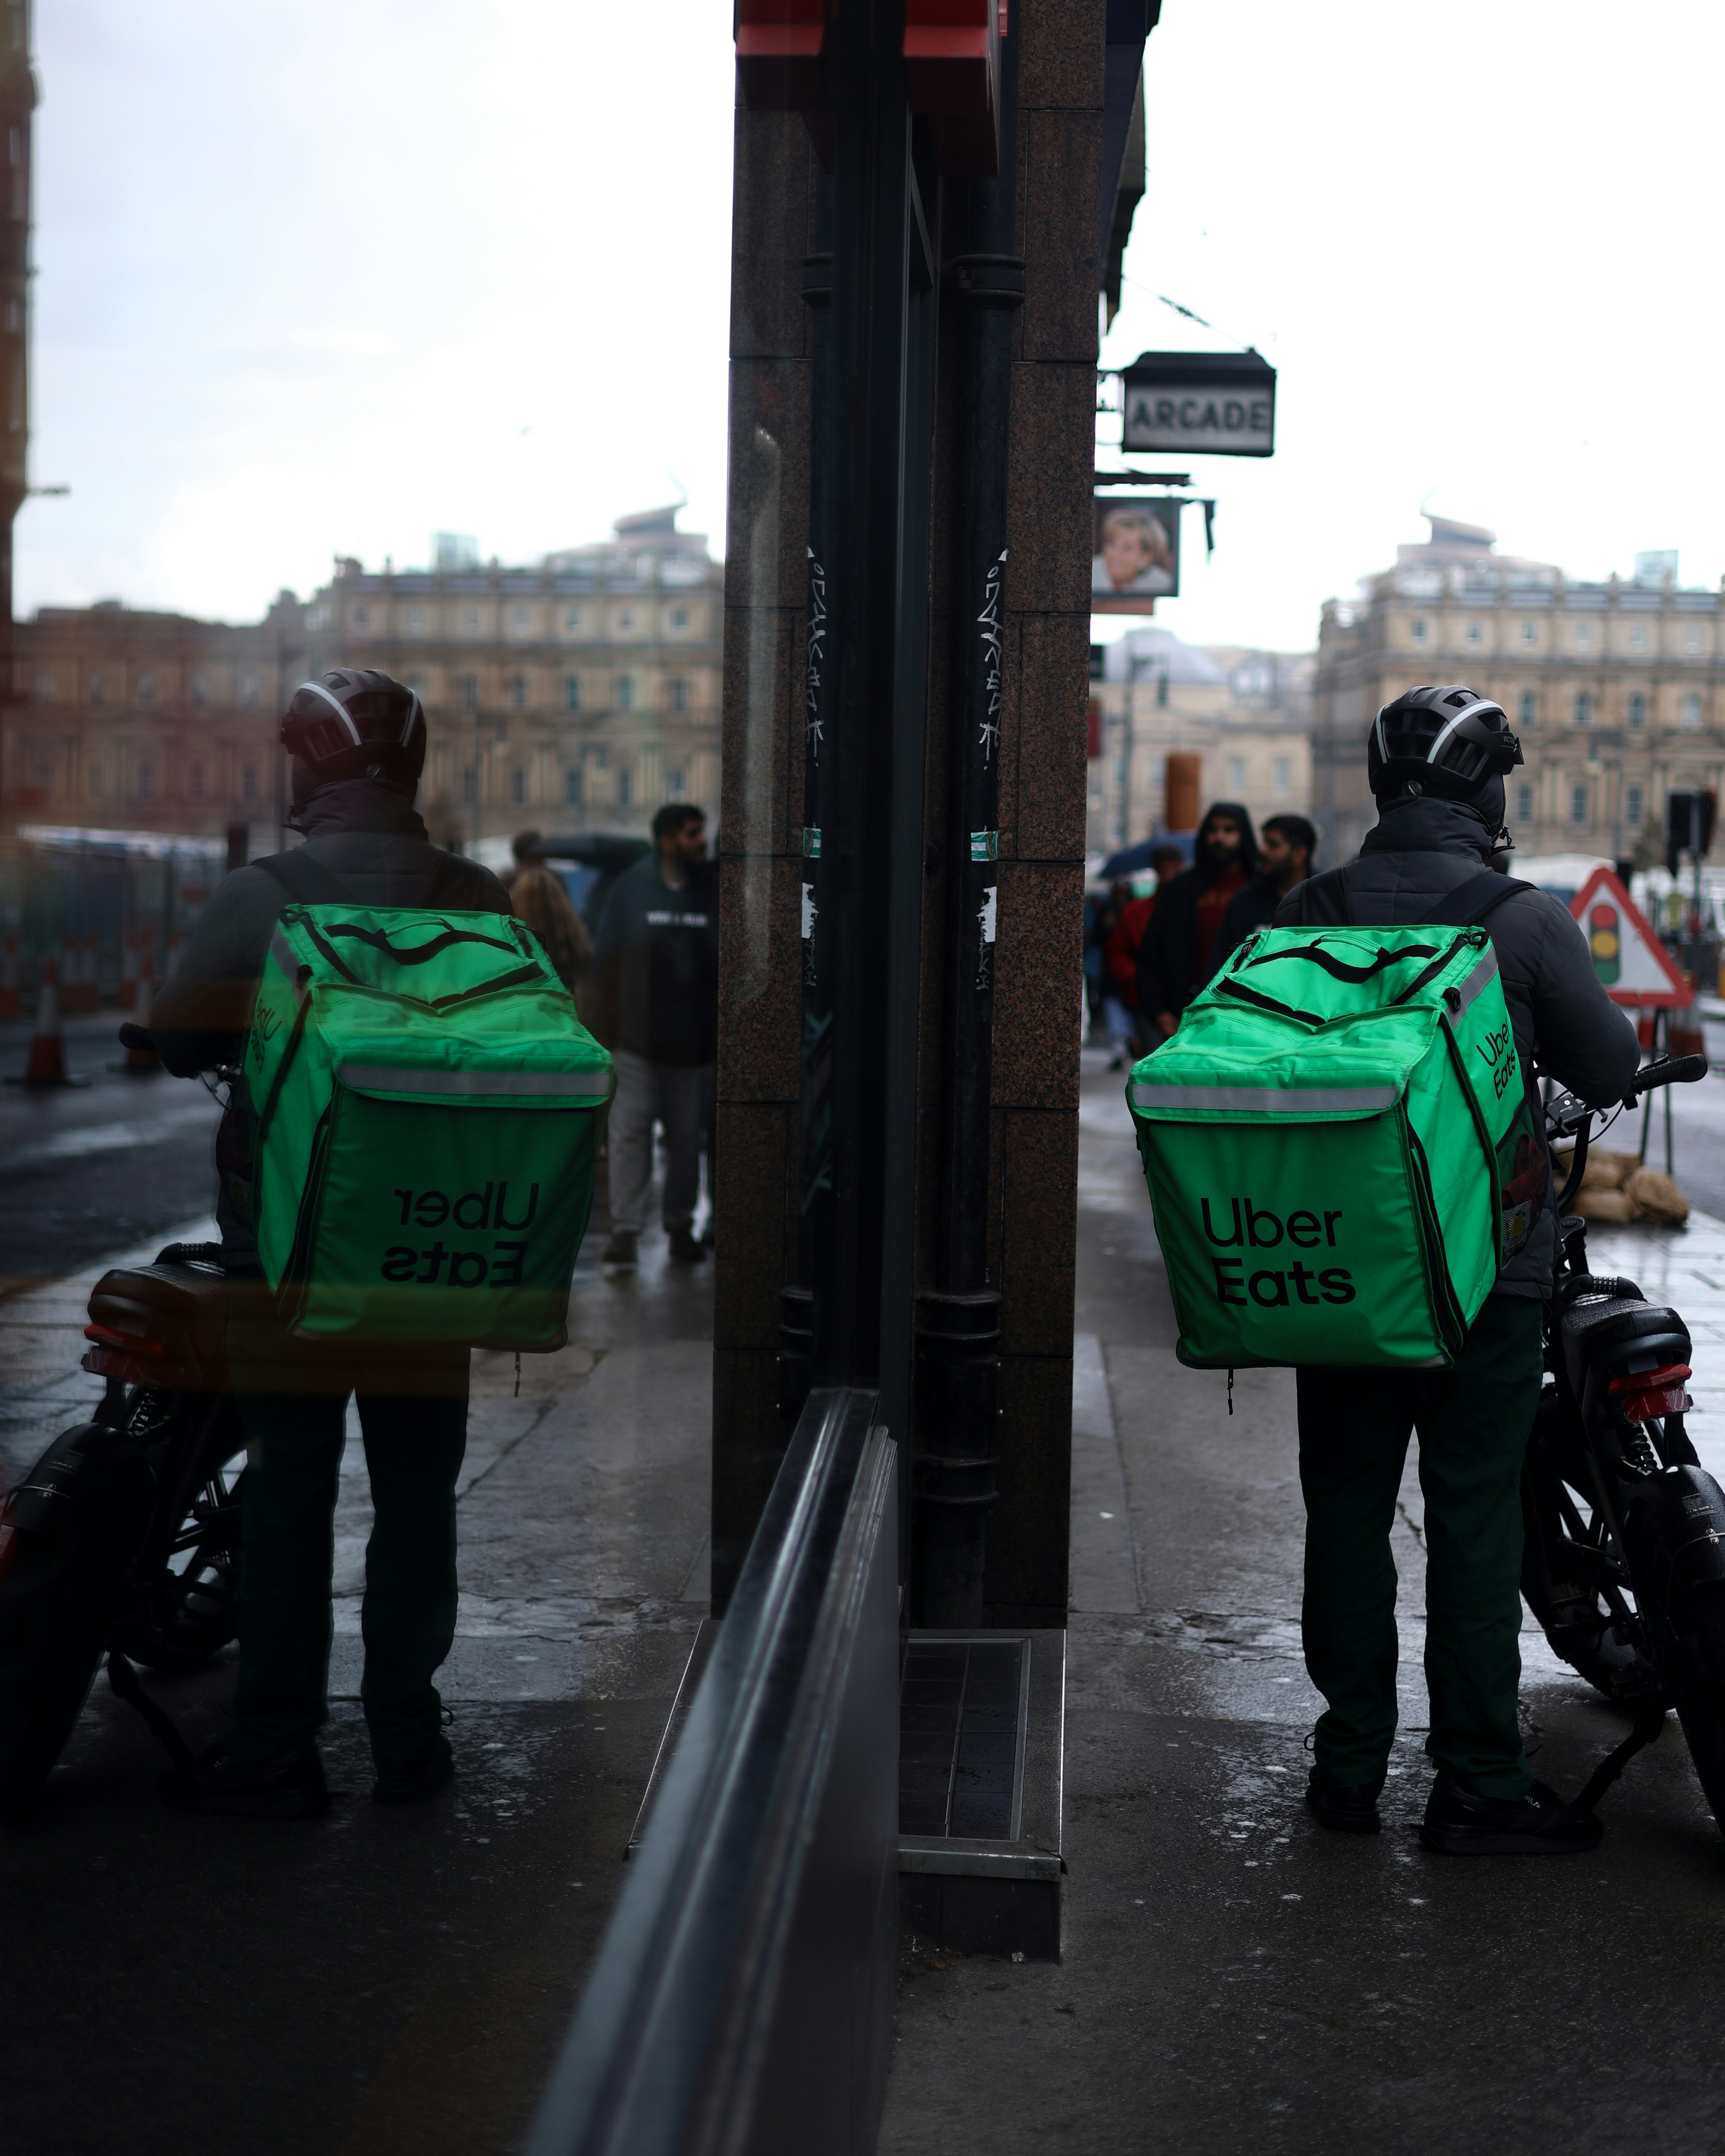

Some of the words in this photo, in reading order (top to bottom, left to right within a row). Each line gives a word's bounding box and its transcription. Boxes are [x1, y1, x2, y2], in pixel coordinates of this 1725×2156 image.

[1131, 398, 1271, 431] ARCADE
[1476, 1017, 1510, 1067] Uber
[1493, 1048, 1515, 1101] Eats
[1201, 1197, 1342, 1248] Uber
[1211, 1257, 1356, 1307] Eats
